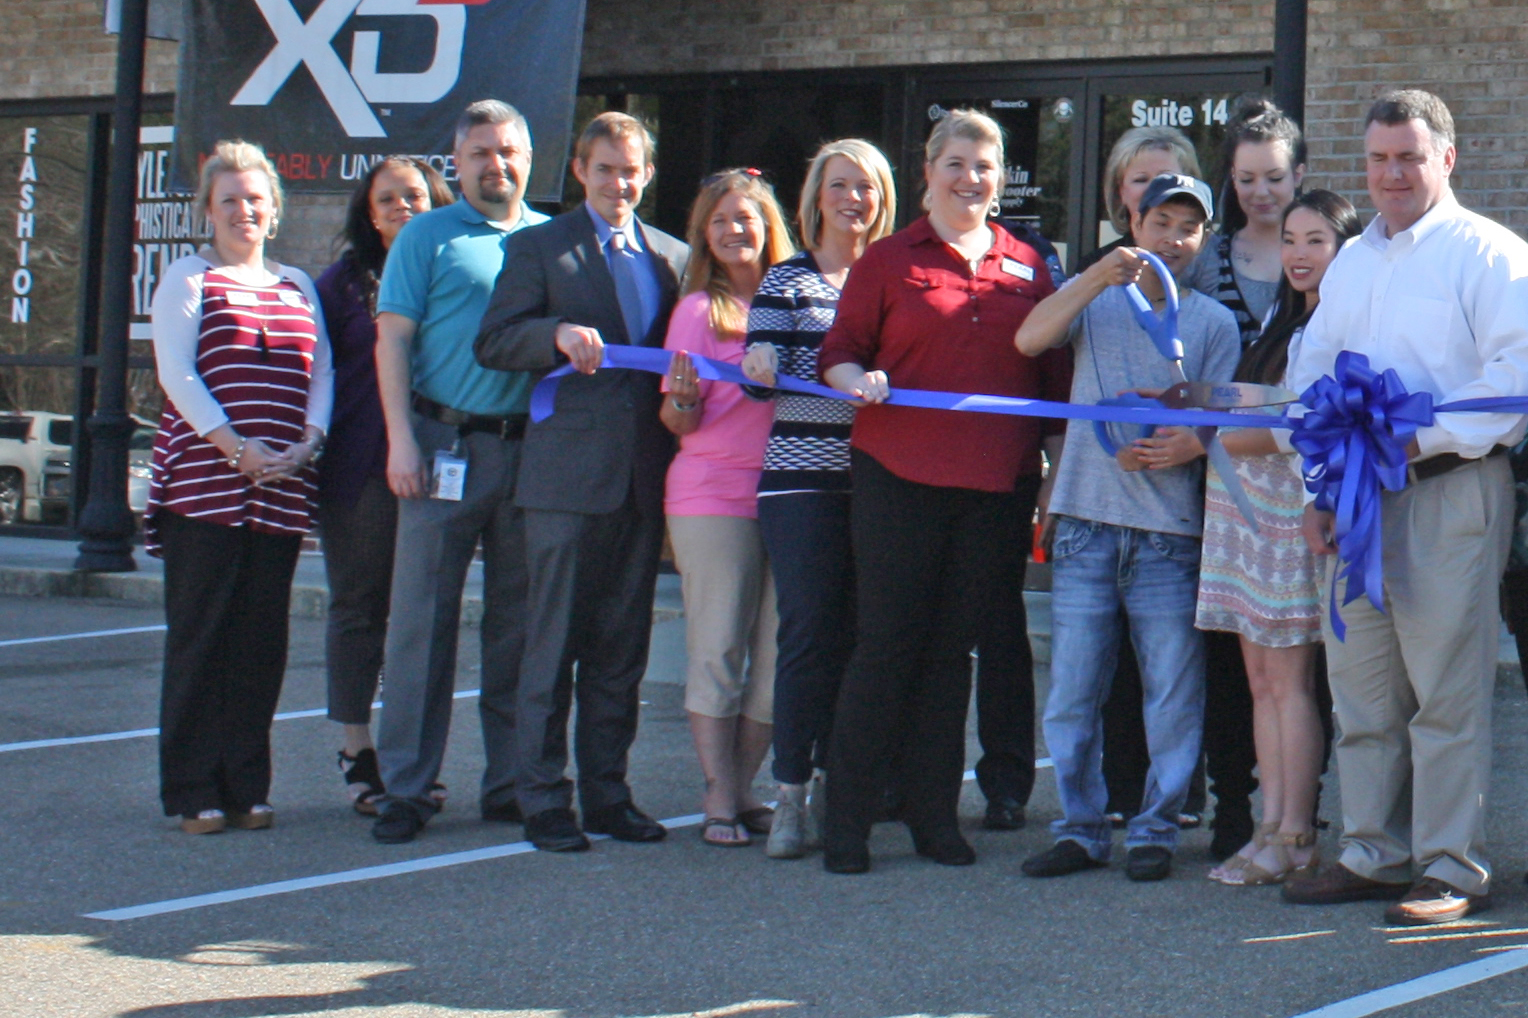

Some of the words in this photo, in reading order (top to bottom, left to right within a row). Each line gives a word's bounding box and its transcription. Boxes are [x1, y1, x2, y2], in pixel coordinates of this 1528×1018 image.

[1131, 99, 1194, 127] Suite
[1201, 99, 1229, 125] 14
[136, 149, 168, 199] YLE
[11, 128, 38, 323] FASHION
